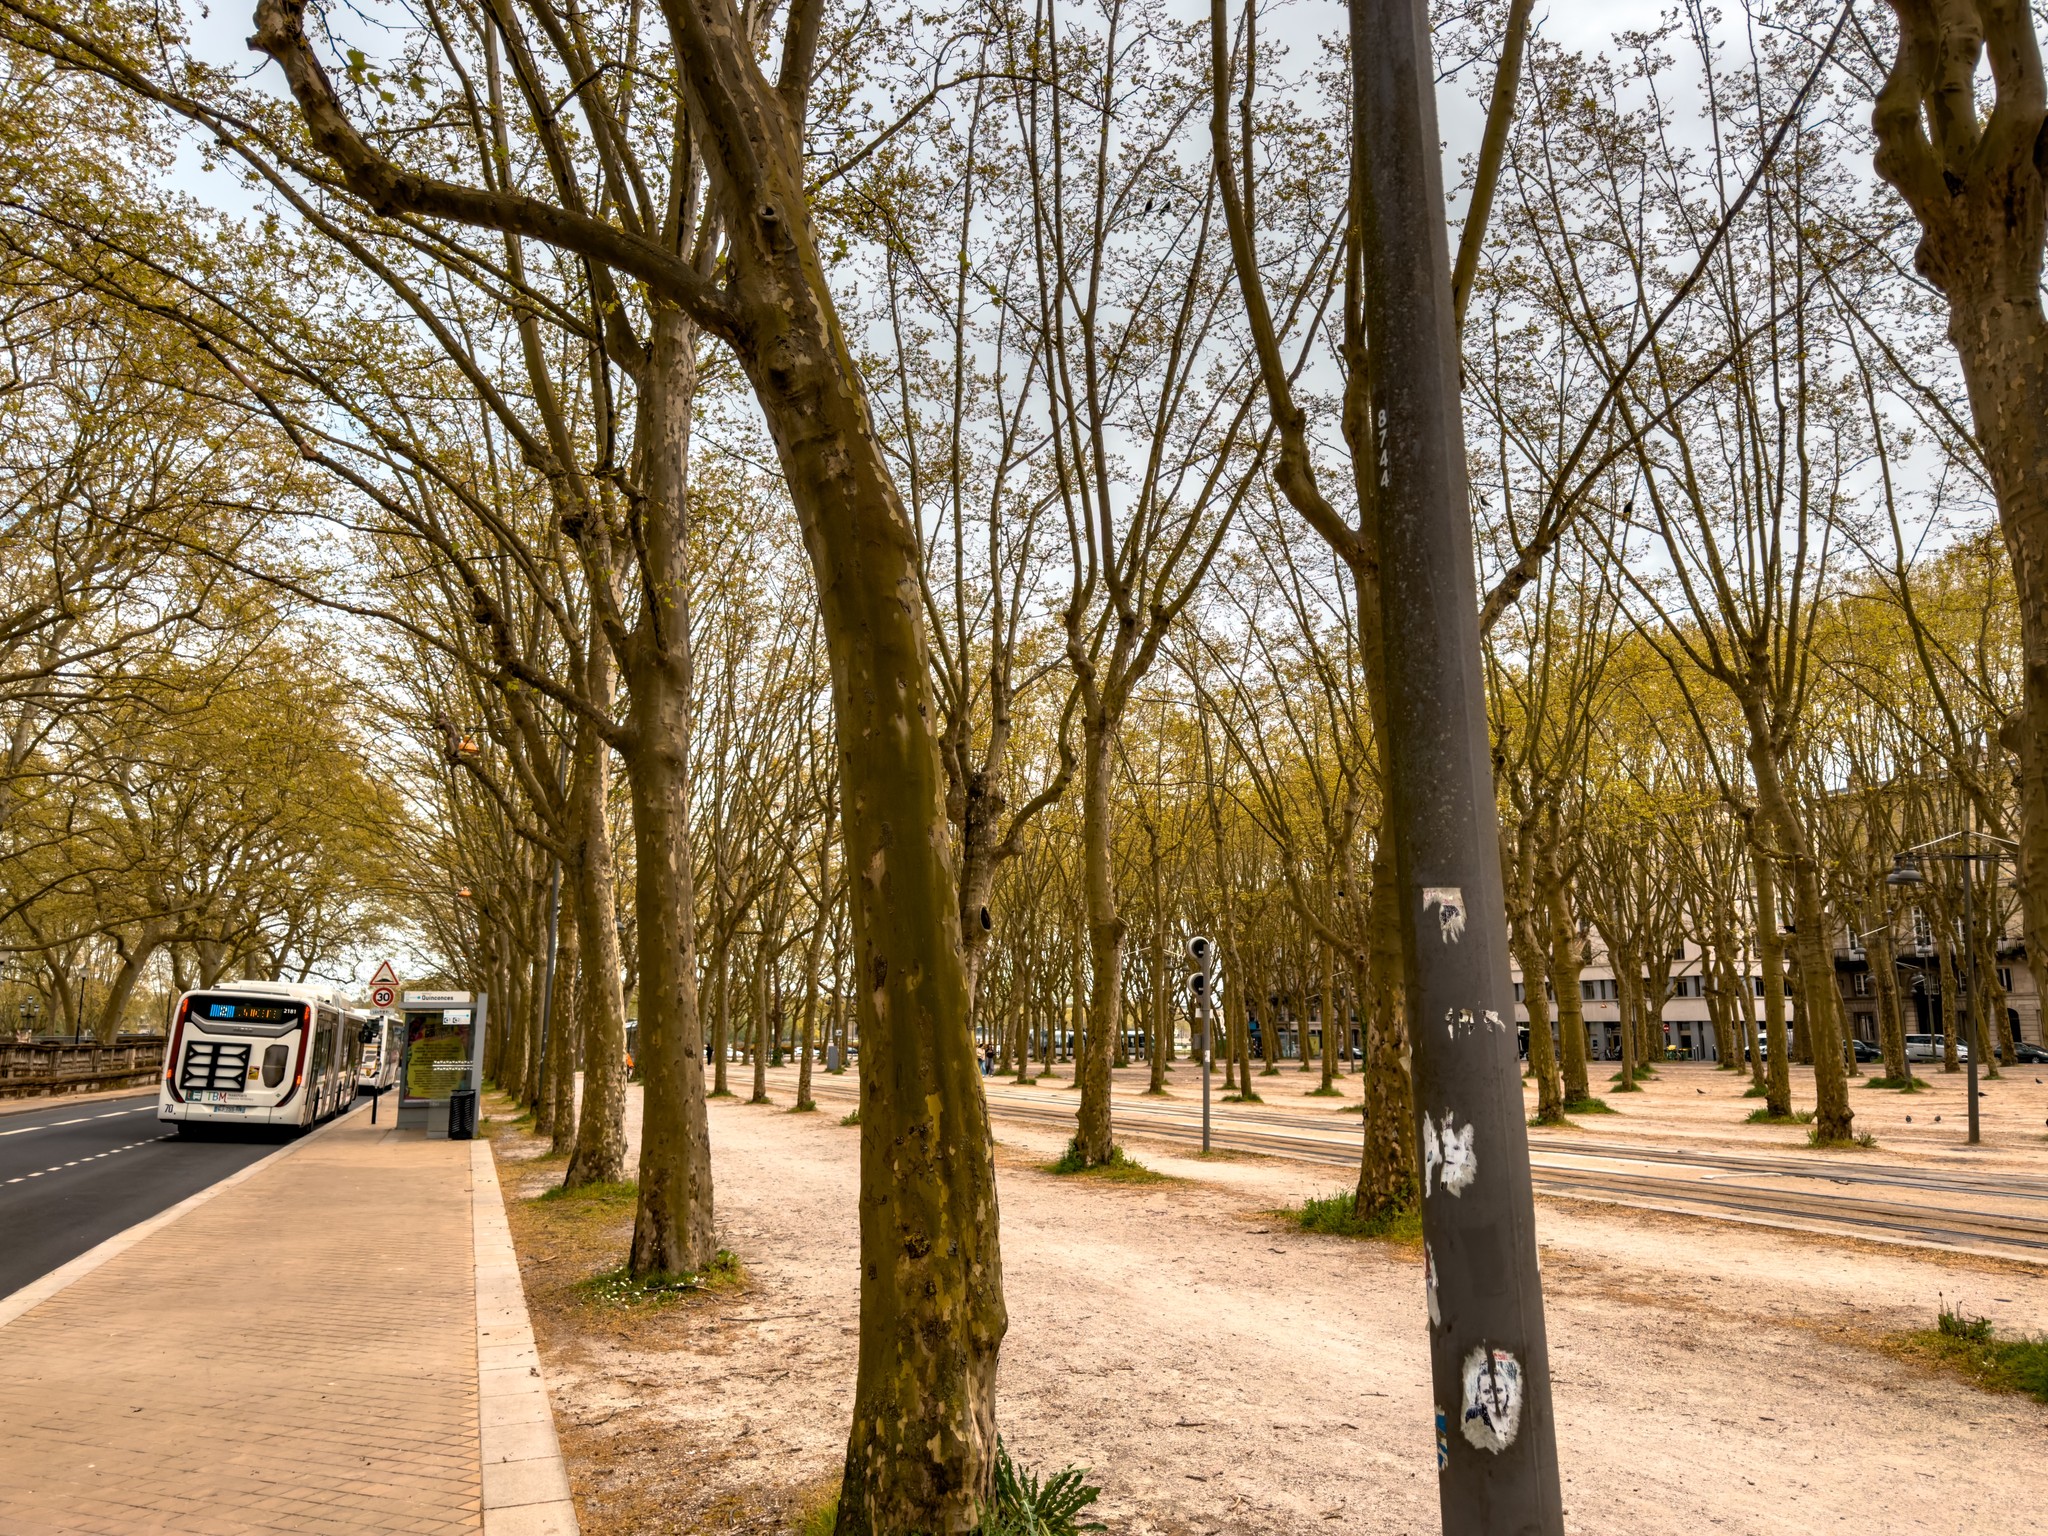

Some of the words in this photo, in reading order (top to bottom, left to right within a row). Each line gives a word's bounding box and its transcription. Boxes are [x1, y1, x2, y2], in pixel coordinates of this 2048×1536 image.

[1378, 409, 1389, 487] 8744
[377, 992, 390, 1002] 30
[206, 1091, 228, 1103] TBM
[165, 1103, 174, 1113] 70
